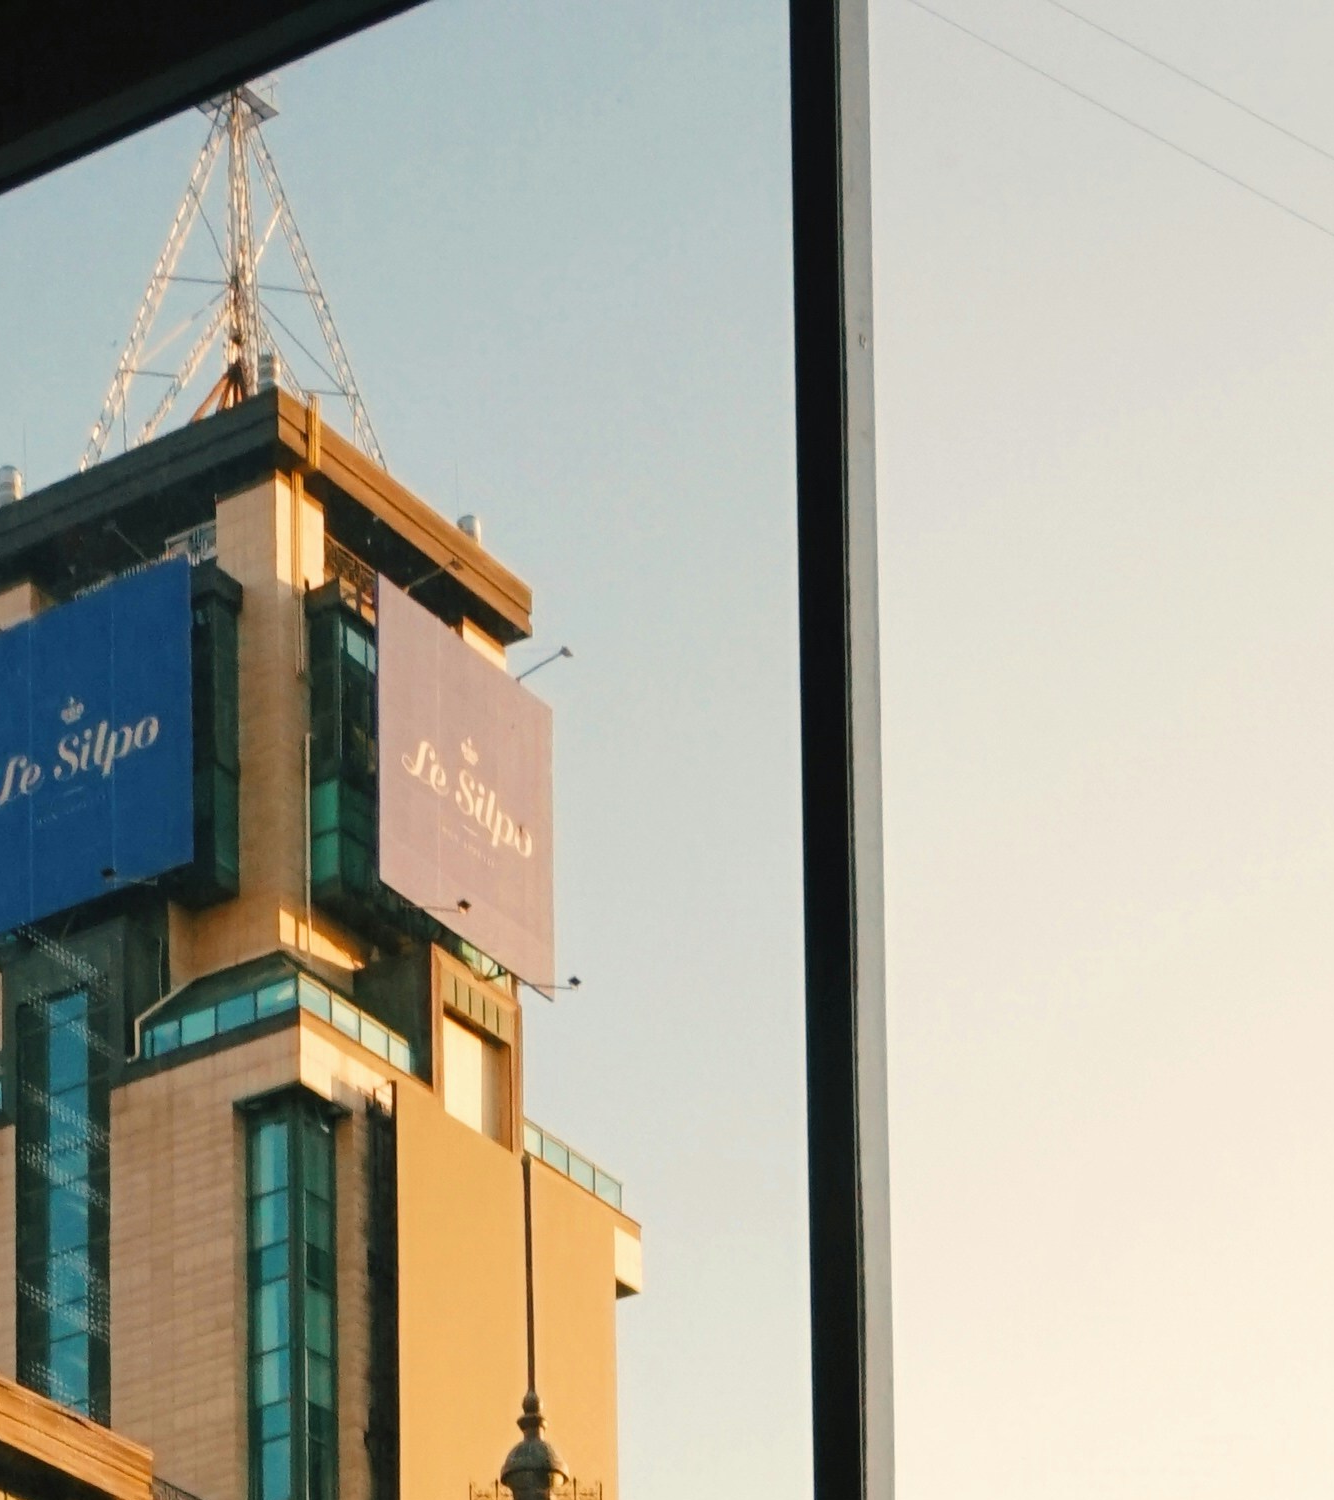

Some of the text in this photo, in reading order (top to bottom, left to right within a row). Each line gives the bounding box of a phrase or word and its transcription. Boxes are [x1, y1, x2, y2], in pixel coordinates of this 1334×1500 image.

[53, 716, 159, 780] Silpo
[401, 740, 450, 796] Le
[455, 769, 533, 858] Silpo
